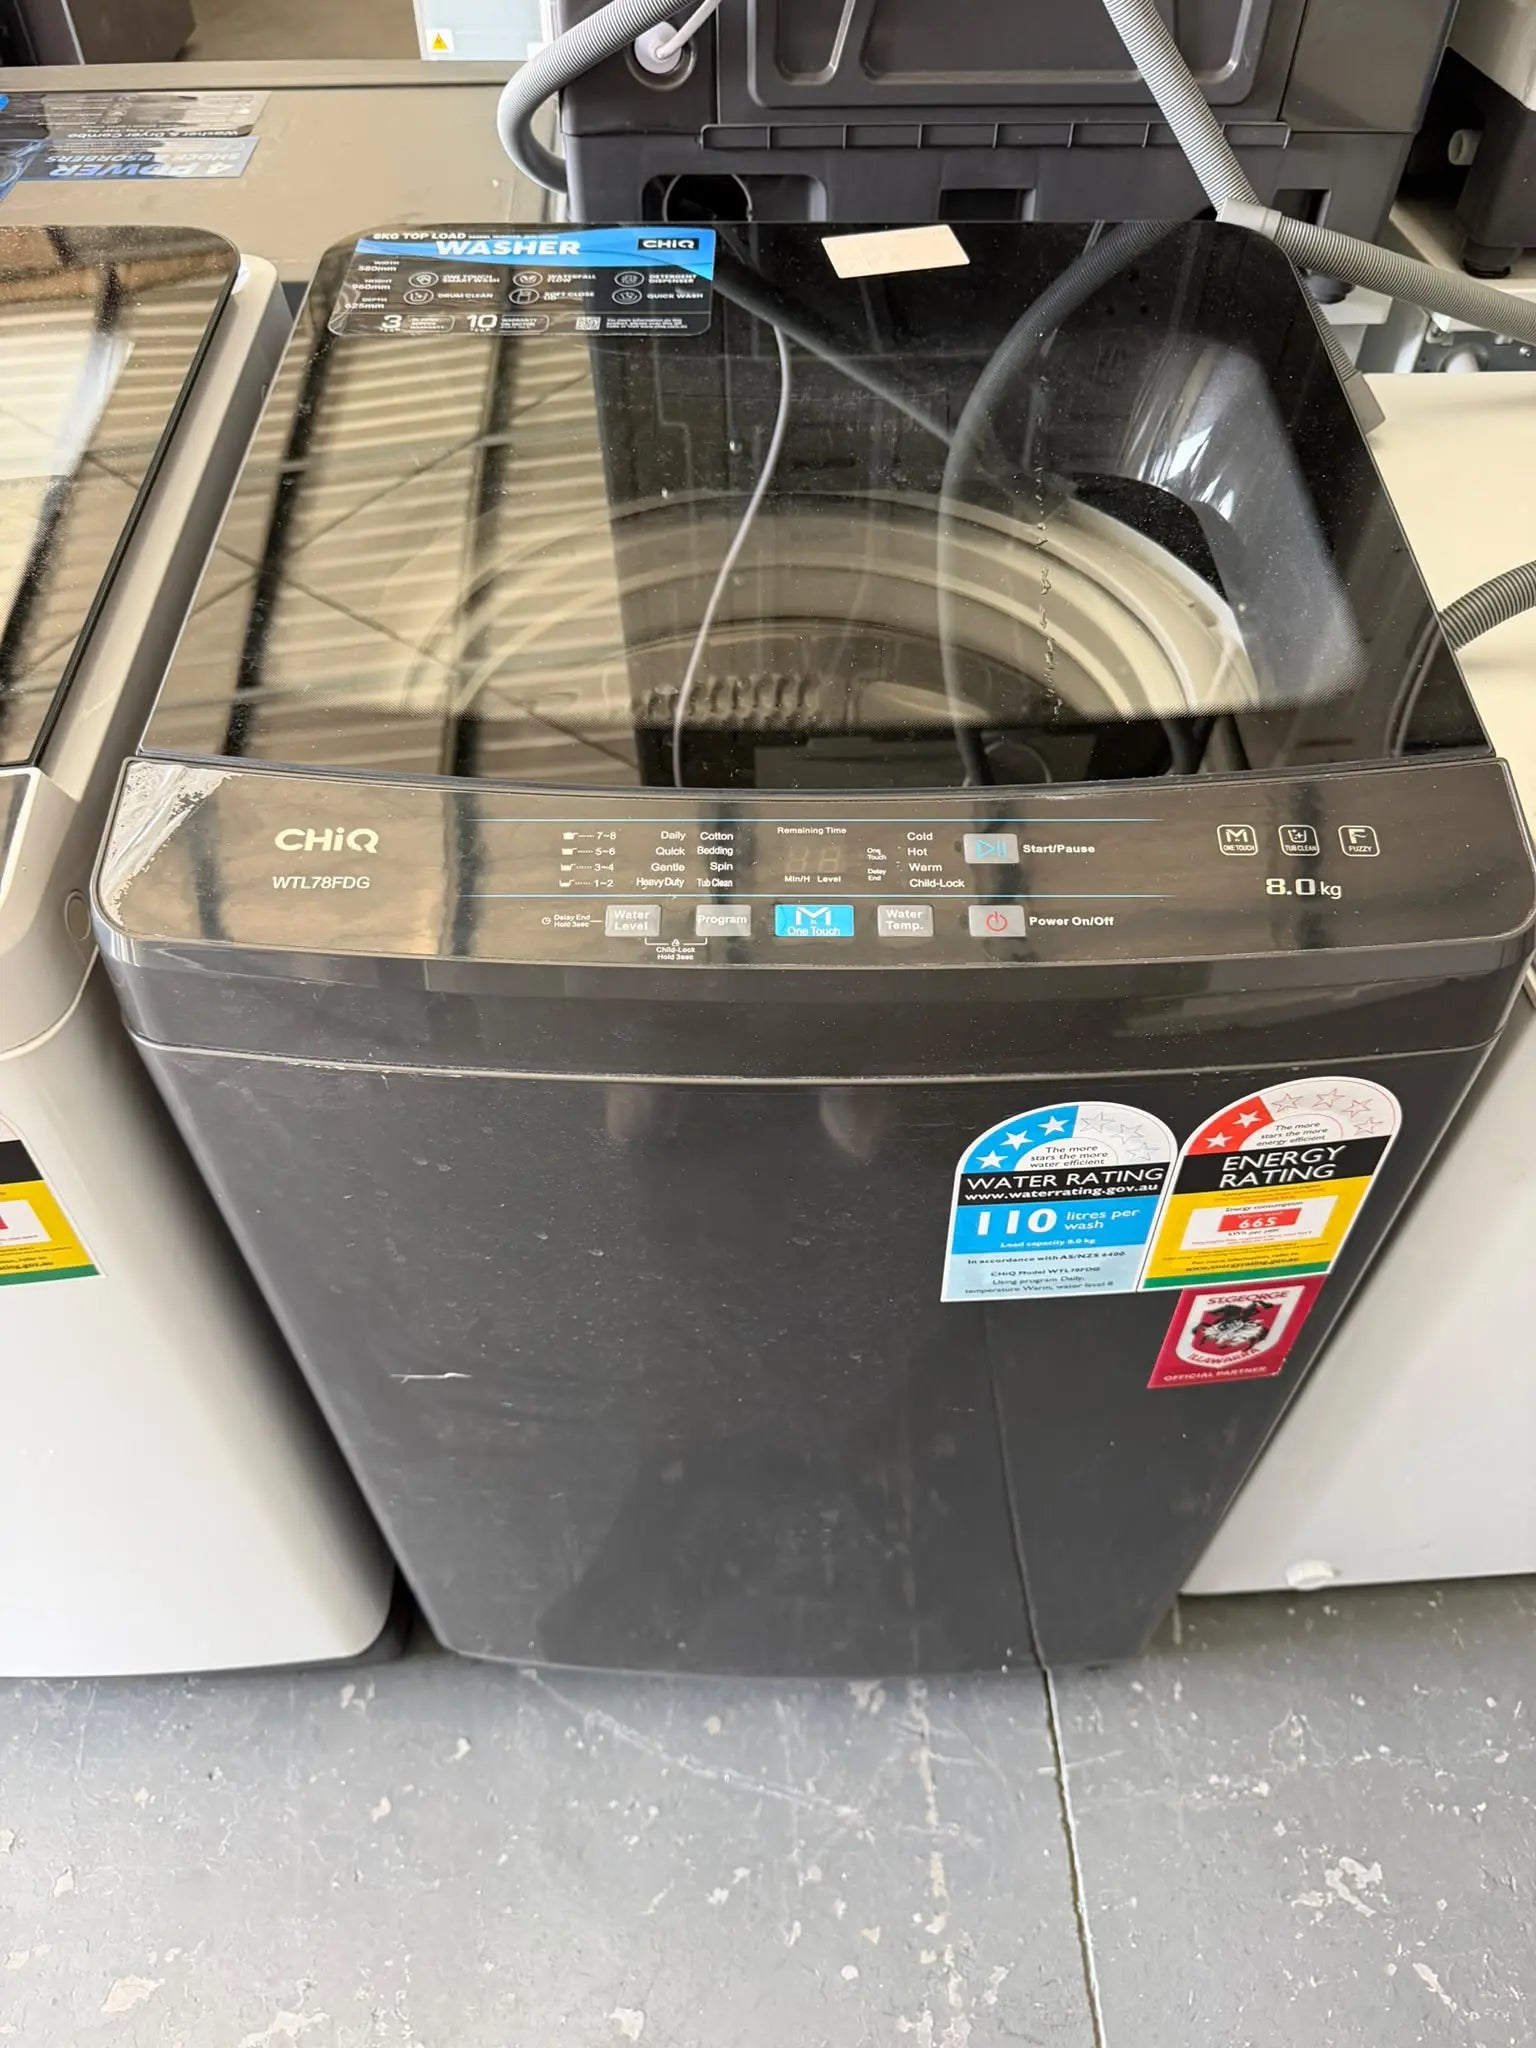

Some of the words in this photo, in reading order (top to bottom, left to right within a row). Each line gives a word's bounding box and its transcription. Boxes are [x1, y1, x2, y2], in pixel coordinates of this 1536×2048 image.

[178, 130, 239, 138] Washer
[46, 153, 170, 162] ABSORBERS
[50, 162, 198, 177] POWER
[211, 162, 235, 176] 4
[402, 232, 429, 240] TOP
[431, 232, 466, 240] LOAD
[435, 240, 581, 255] WASHER
[381, 315, 402, 329] 3
[467, 314, 498, 329] 10
[777, 827, 824, 835] Remaining
[274, 827, 379, 853] CHiQ
[661, 831, 686, 842] Daily
[700, 832, 734, 841] Cotton
[907, 832, 934, 841] Cold
[656, 847, 685, 857] Quick
[697, 846, 734, 856] Bedding
[907, 847, 929, 856] Hot
[1022, 843, 1096, 854] Start/Pause
[1285, 844, 1298, 852] TUB
[651, 862, 686, 872] Gentle
[710, 862, 734, 872] Spin
[908, 863, 943, 872] Warm
[272, 876, 371, 889] WTL78FDG
[636, 877, 665, 888] Heavy
[664, 877, 685, 888] Duty
[697, 878, 711, 888] Tub
[711, 878, 733, 887] Clean
[817, 875, 841, 883] Level
[909, 879, 965, 888] Child-Lock
[554, 914, 575, 922] Delay
[576, 914, 590, 922] End
[614, 910, 650, 920] Water
[886, 909, 922, 919] Water
[697, 914, 748, 926] Program
[1029, 915, 1068, 926] Power
[1071, 915, 1114, 926] On/Off
[614, 923, 648, 931] Level
[887, 920, 924, 931] Temp.
[787, 927, 809, 936] One
[811, 926, 840, 936] Touch
[656, 946, 695, 954] Child-Lock
[1063, 1159, 1105, 1167] efficient
[1222, 1145, 1347, 1172] ENERGY
[967, 1175, 1057, 1191] WATER
[1065, 1167, 1165, 1187] RATING
[1219, 1164, 1337, 1188] RATING
[964, 1183, 1159, 1201] www.waterrating.gov.au
[1066, 1210, 1107, 1221] litres
[1111, 1209, 1140, 1220] per
[977, 1208, 1058, 1236] 110
[1064, 1220, 1104, 1231] wash
[1025, 1240, 1065, 1248] capacity
[1019, 1277, 1058, 1285] program
[965, 1287, 1020, 1295] temperature
[1186, 1348, 1261, 1364] ILLAWARRA
[1163, 1371, 1214, 1381] OFFICIAL
[1216, 1365, 1267, 1377] PARTNER
